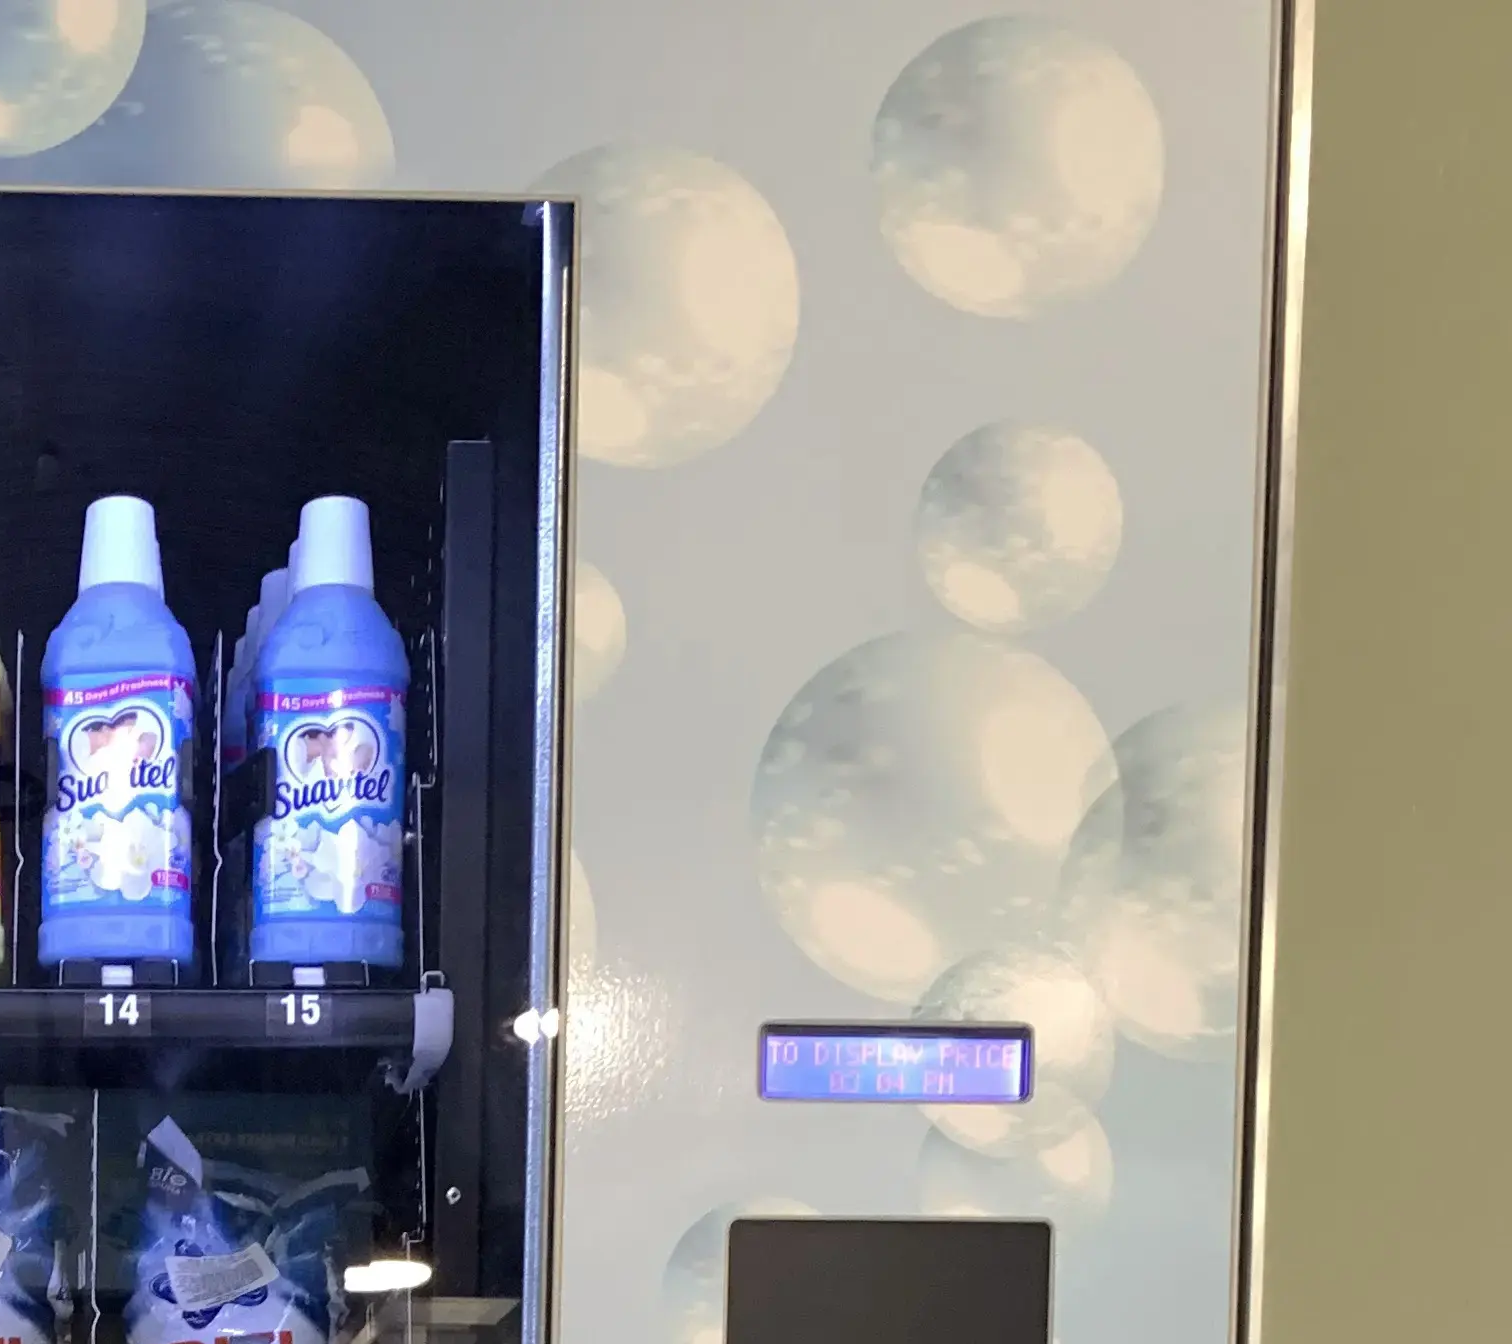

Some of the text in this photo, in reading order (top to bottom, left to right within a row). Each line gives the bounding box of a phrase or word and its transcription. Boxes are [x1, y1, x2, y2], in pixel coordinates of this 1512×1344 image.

[63, 690, 84, 705] 45
[84, 688, 108, 701] Days
[120, 678, 171, 694] Freshness
[281, 697, 301, 711] 45
[55, 756, 176, 813] Suaitel
[99, 993, 139, 1025] 14
[280, 994, 321, 1025] 15
[767, 1040, 1018, 1071] TO DISPLAY PRICE
